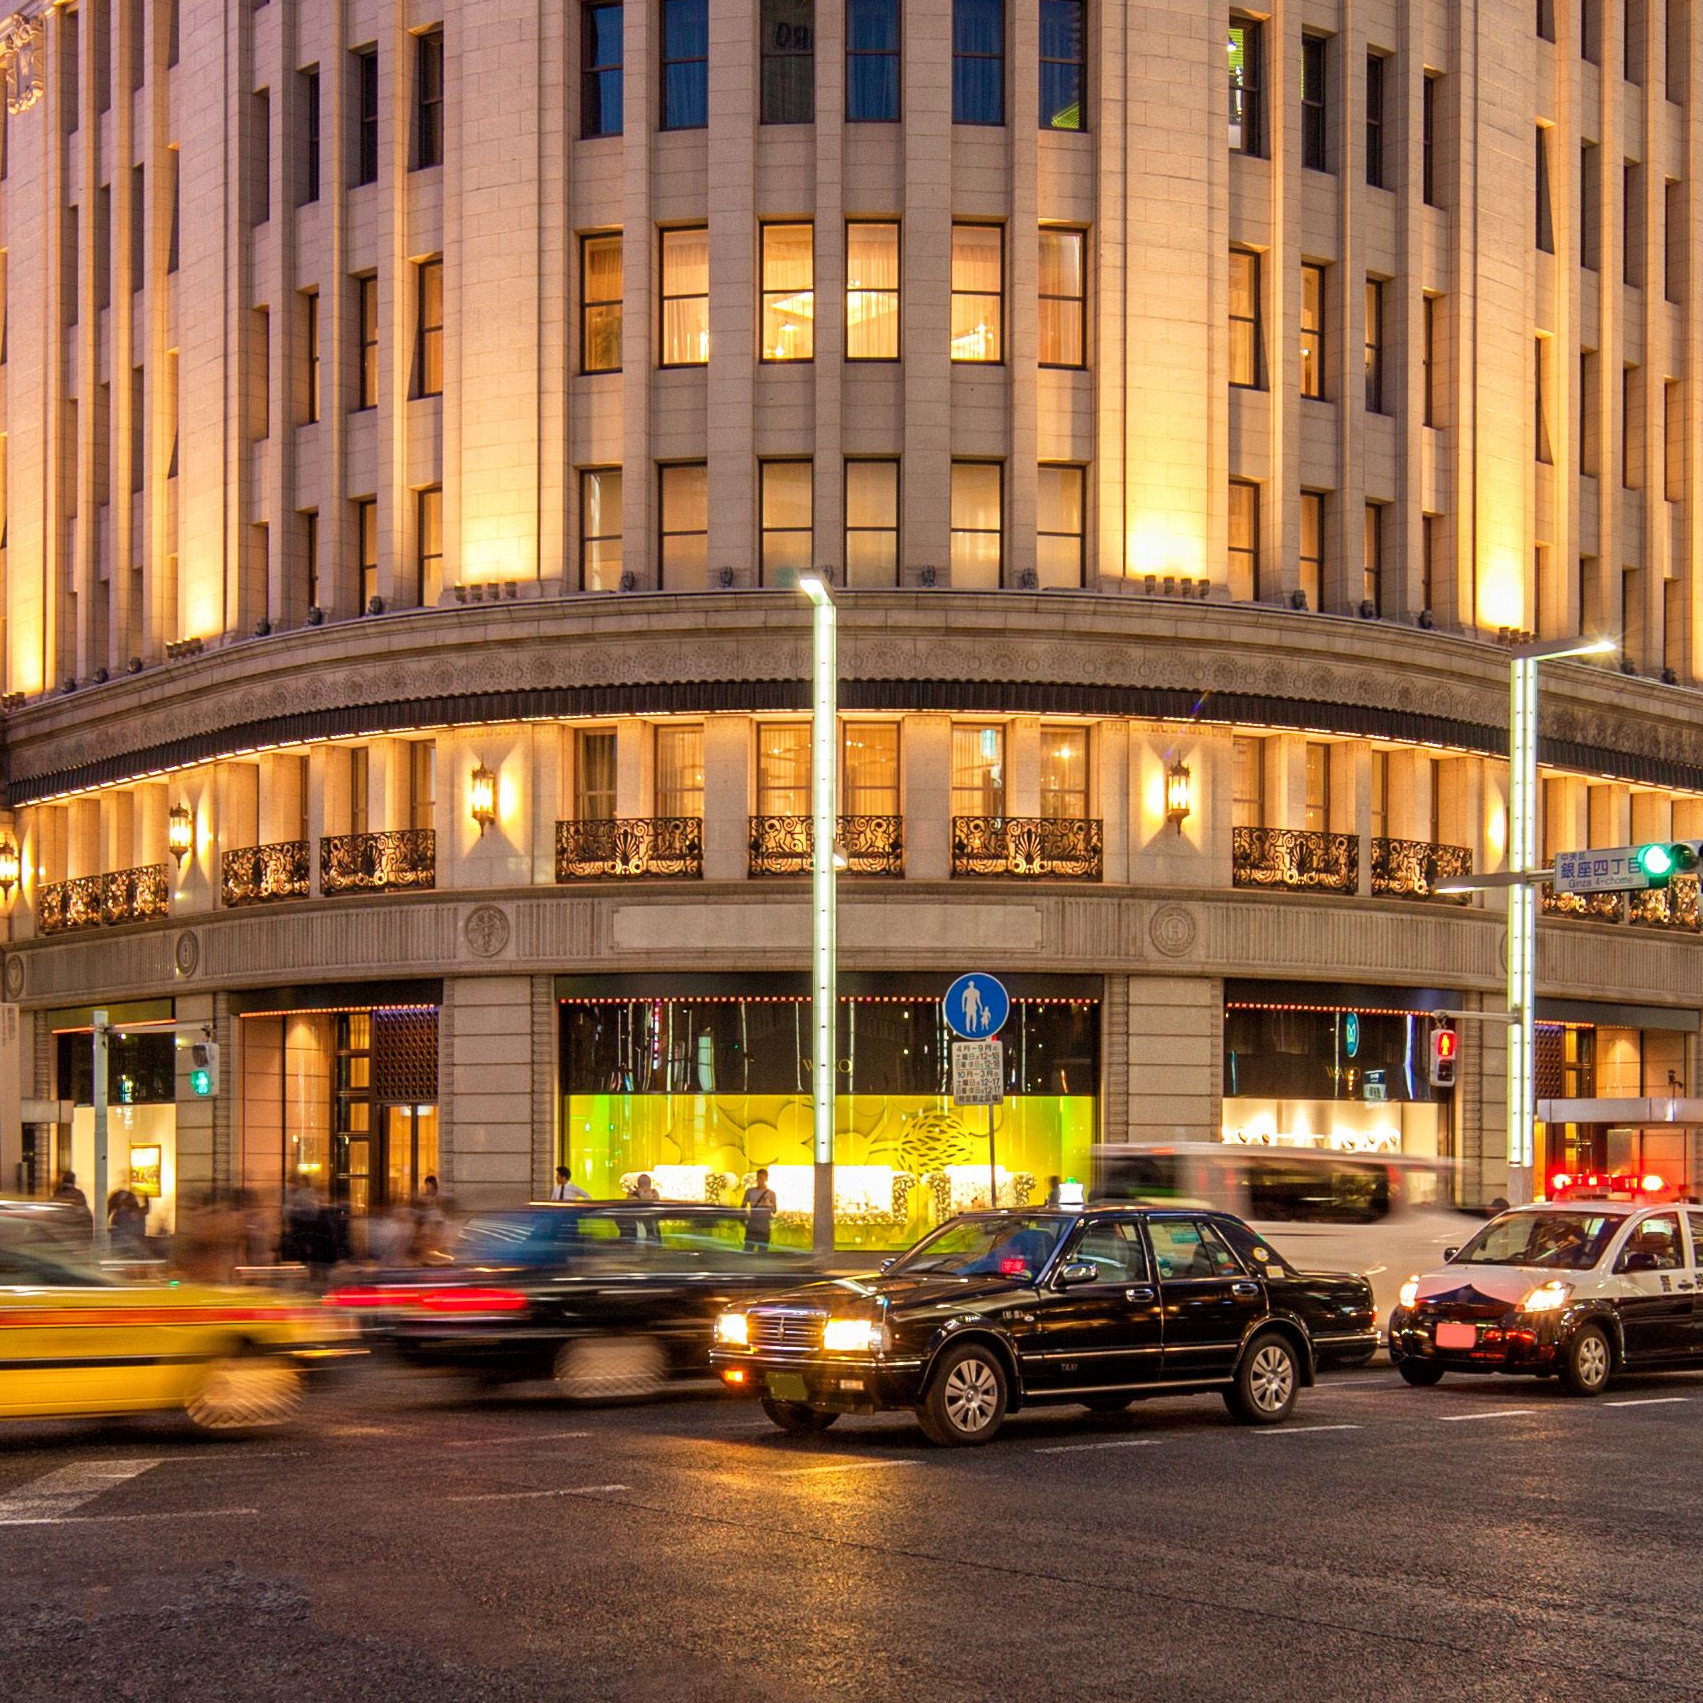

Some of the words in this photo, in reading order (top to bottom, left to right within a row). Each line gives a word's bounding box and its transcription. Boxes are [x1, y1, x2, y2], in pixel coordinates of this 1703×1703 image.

[1561, 857, 1642, 880] 銀座四丁目
[1568, 879, 1592, 889] Ginza
[802, 1058, 852, 1073] WO
